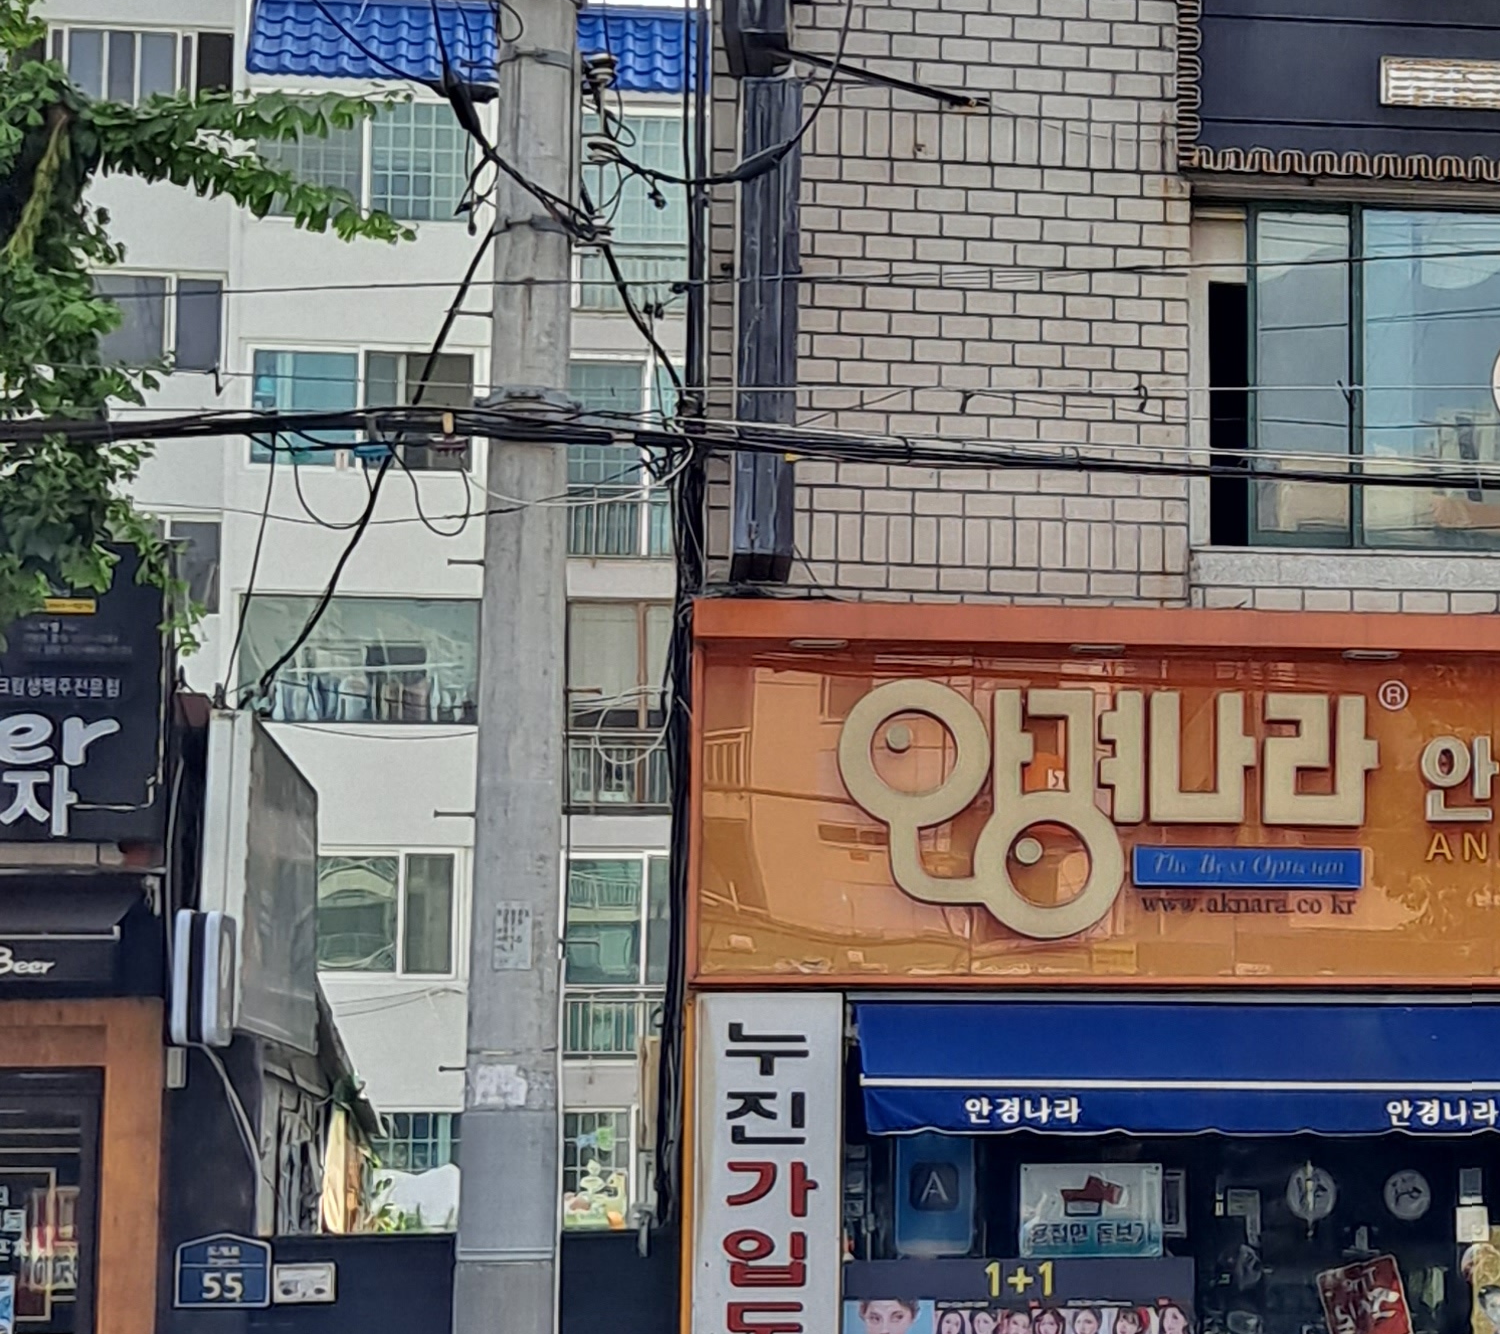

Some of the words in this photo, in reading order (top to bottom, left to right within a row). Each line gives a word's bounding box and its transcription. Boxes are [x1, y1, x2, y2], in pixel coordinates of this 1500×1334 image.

[1, 764, 78, 837] 자
[964, 1097, 1082, 1125] 안경나라
[1386, 1099, 1500, 1128] 안경나라
[202, 1272, 243, 1299] 55
[984, 1260, 1056, 1298] 1+1
